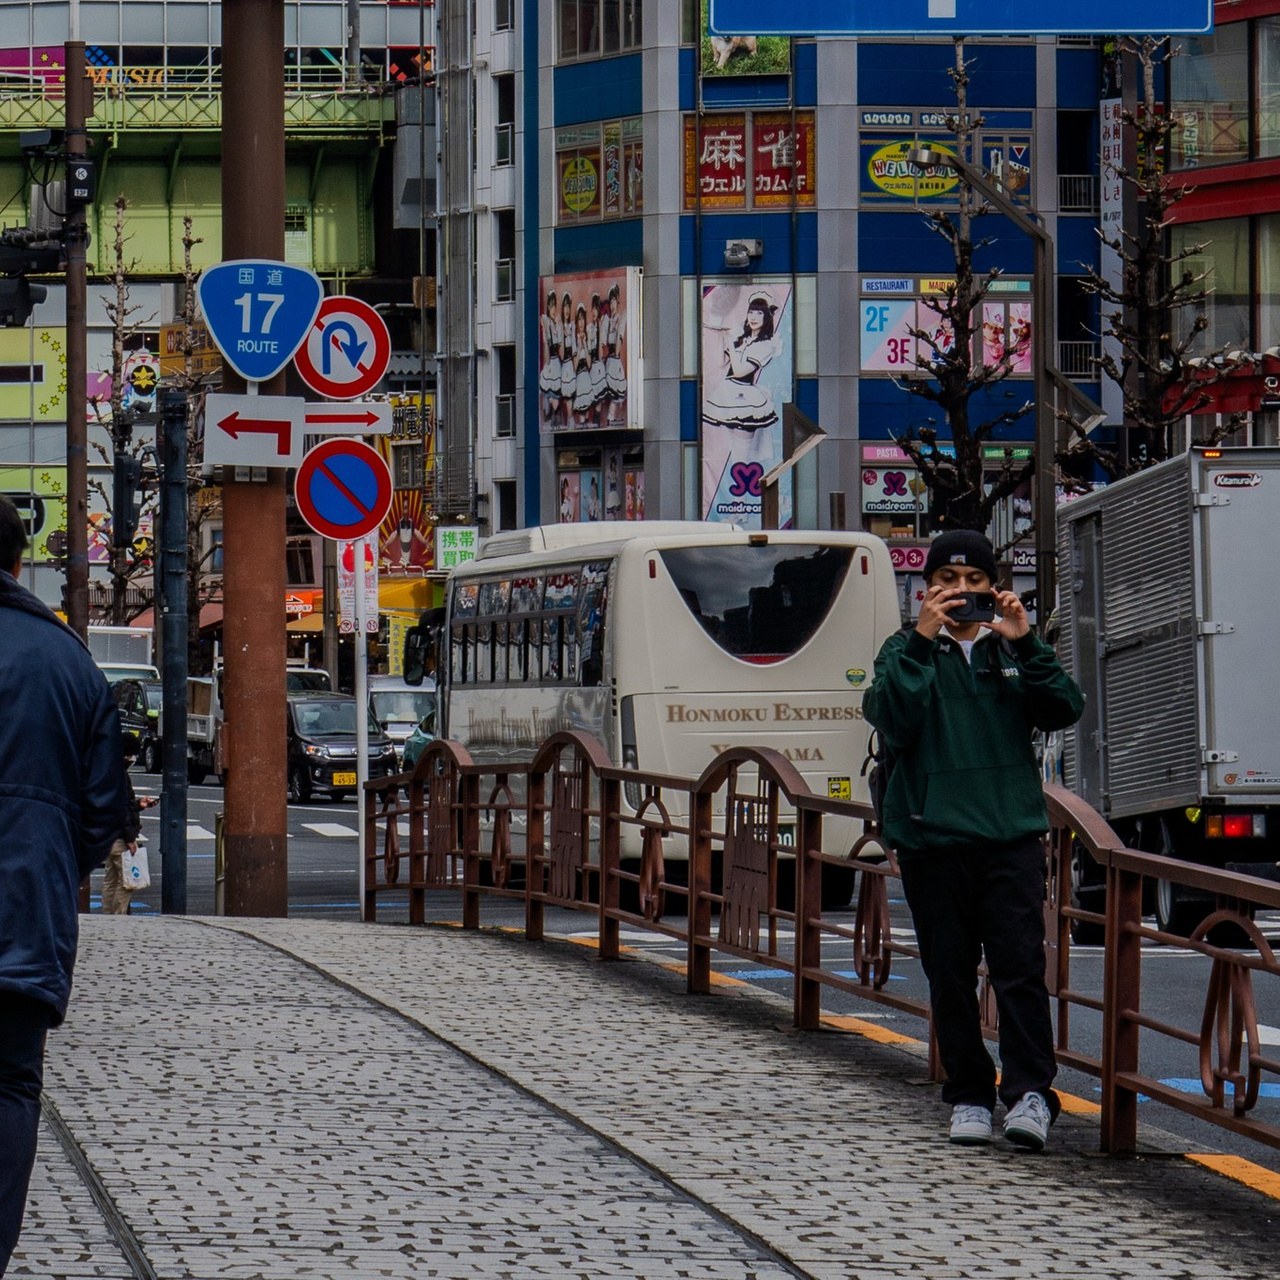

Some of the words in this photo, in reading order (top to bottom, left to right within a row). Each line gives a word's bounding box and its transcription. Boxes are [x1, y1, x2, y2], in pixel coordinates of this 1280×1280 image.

[238, 268, 283, 287] 国道
[866, 280, 909, 291] RESTAURANT
[234, 292, 285, 335] 17
[865, 306, 890, 333] 2F
[237, 340, 279, 355] ROUTE
[887, 338, 911, 365] 3F
[876, 448, 899, 458] PASTA
[443, 530, 475, 548] 携帯
[665, 703, 768, 724] HONMOKU
[773, 702, 864, 723] EXPRESS
